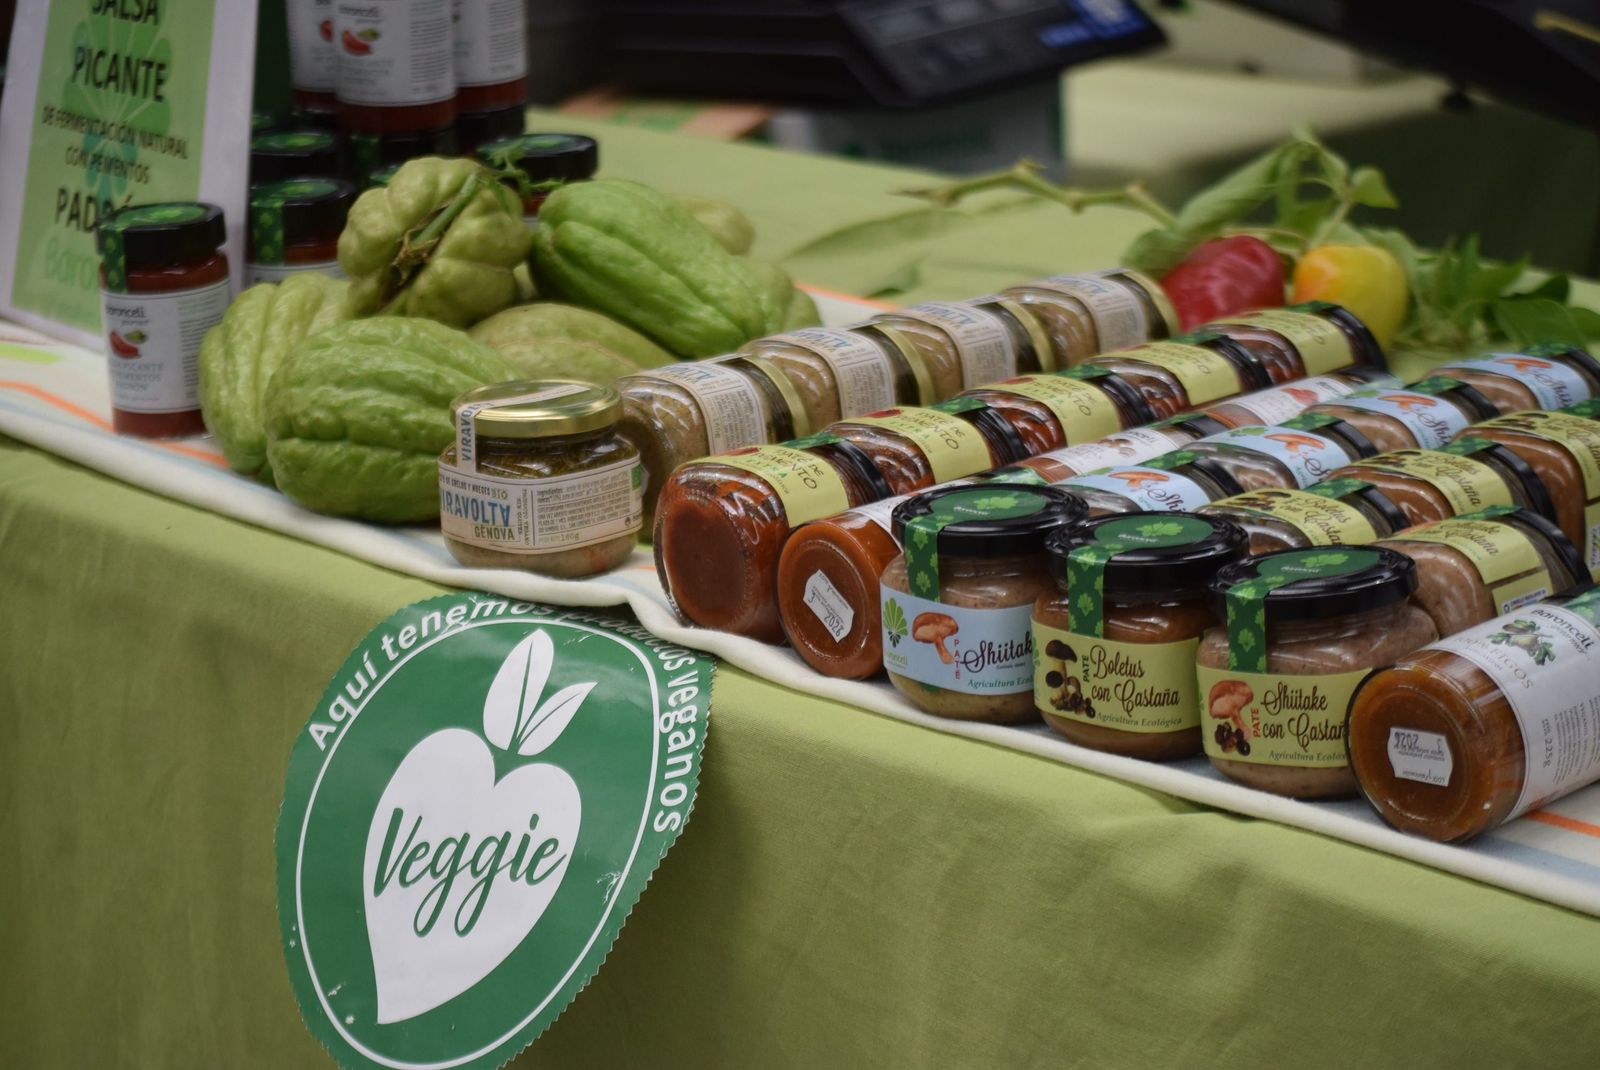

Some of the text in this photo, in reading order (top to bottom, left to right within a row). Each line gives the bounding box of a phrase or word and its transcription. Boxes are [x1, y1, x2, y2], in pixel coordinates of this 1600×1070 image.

[91, 0, 161, 25] SALSA
[72, 46, 167, 102] PICANTE
[65, 146, 88, 168] CON
[138, 128, 189, 159] NATURAL
[491, 487, 508, 500] BIO
[1304, 510, 1342, 546] Casta
[1530, 608, 1595, 651] Baronceli
[953, 638, 961, 680] PATÉ
[960, 631, 1033, 674] Shiitak
[1081, 654, 1090, 683] PATE
[1089, 644, 1146, 680] Boletus
[967, 678, 1015, 691] Agricultura
[1091, 678, 1180, 718] con Castaña
[1260, 681, 1329, 716] Shiitake
[307, 654, 380, 752] Aquí
[381, 598, 555, 662] tenemos
[654, 668, 699, 833] veganos
[1096, 711, 1183, 729] Agricultura Ecológica
[1251, 707, 1262, 738] PATE
[1262, 712, 1346, 753] con Castañ
[1268, 750, 1315, 762] Agricultura
[373, 806, 568, 938] Veggie
